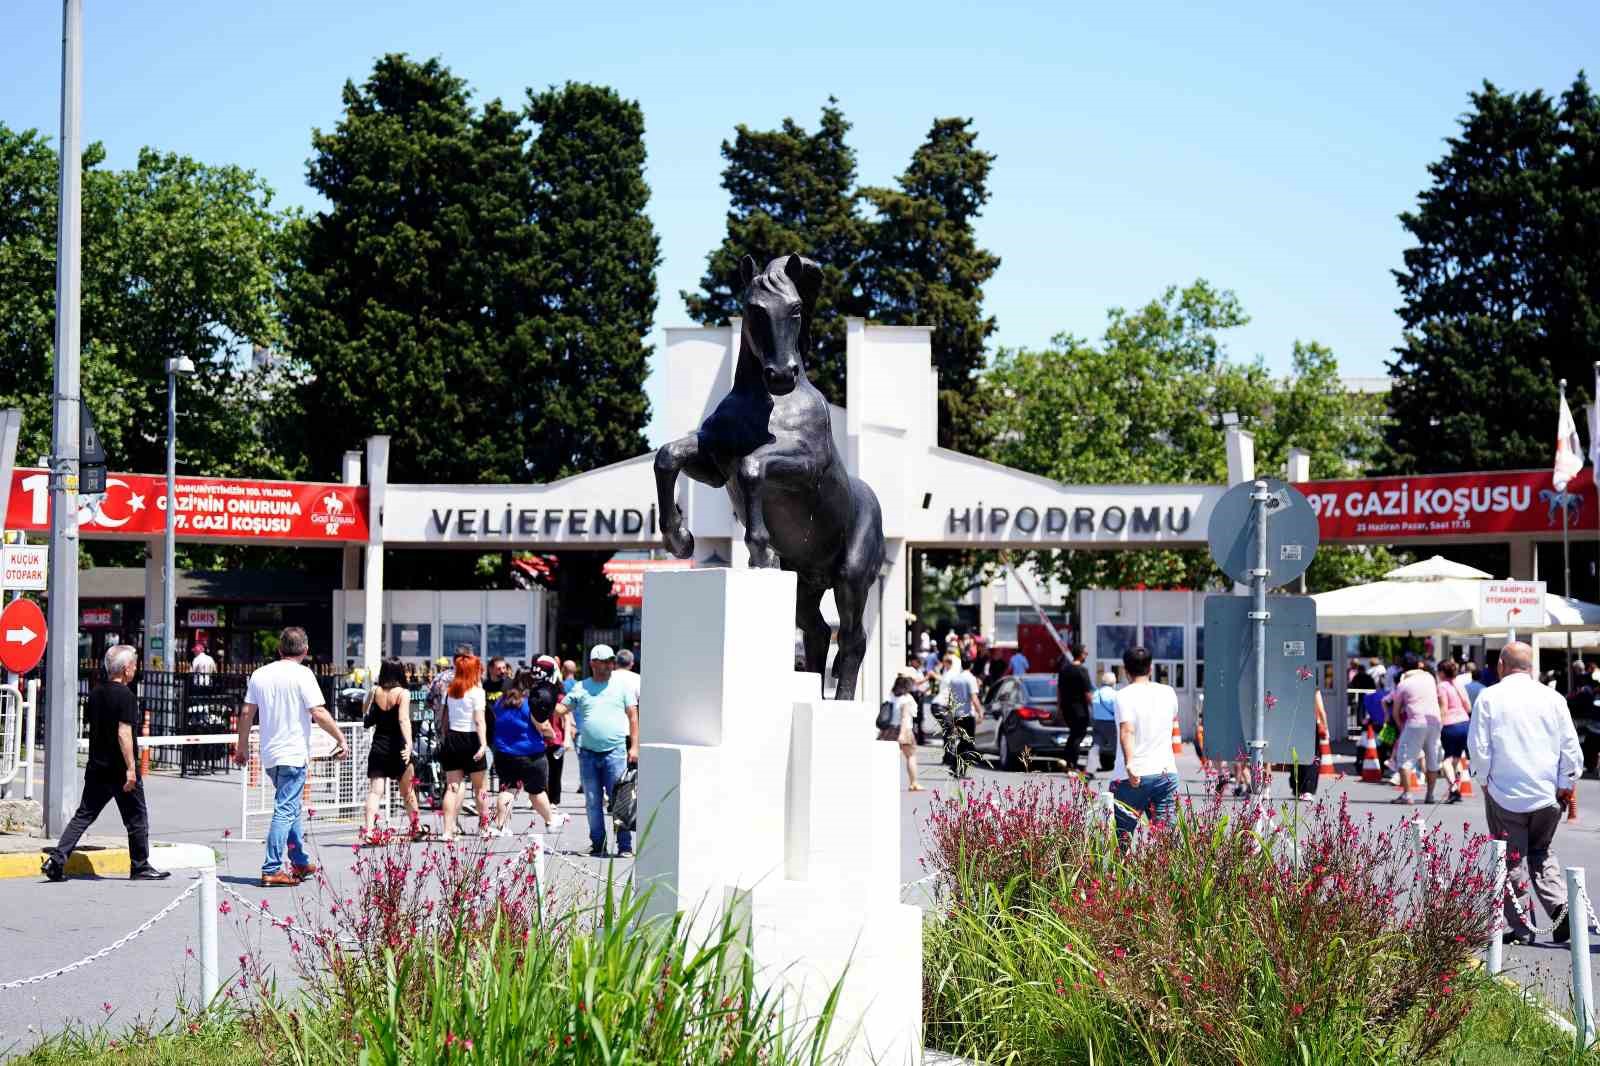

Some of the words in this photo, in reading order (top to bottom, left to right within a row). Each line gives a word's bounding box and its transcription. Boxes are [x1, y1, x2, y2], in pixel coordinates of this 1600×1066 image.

[227, 499, 302, 515] ONURUNA
[1345, 482, 1408, 517] GAZİ
[1414, 485, 1531, 520] KOŞUSU
[192, 512, 229, 530] GAZİ
[231, 516, 291, 534] KOŞUSU
[432, 503, 656, 535] VELİEFENDİ
[949, 501, 1191, 534] HİPODROMU
[6, 570, 42, 580] OTOPARK
